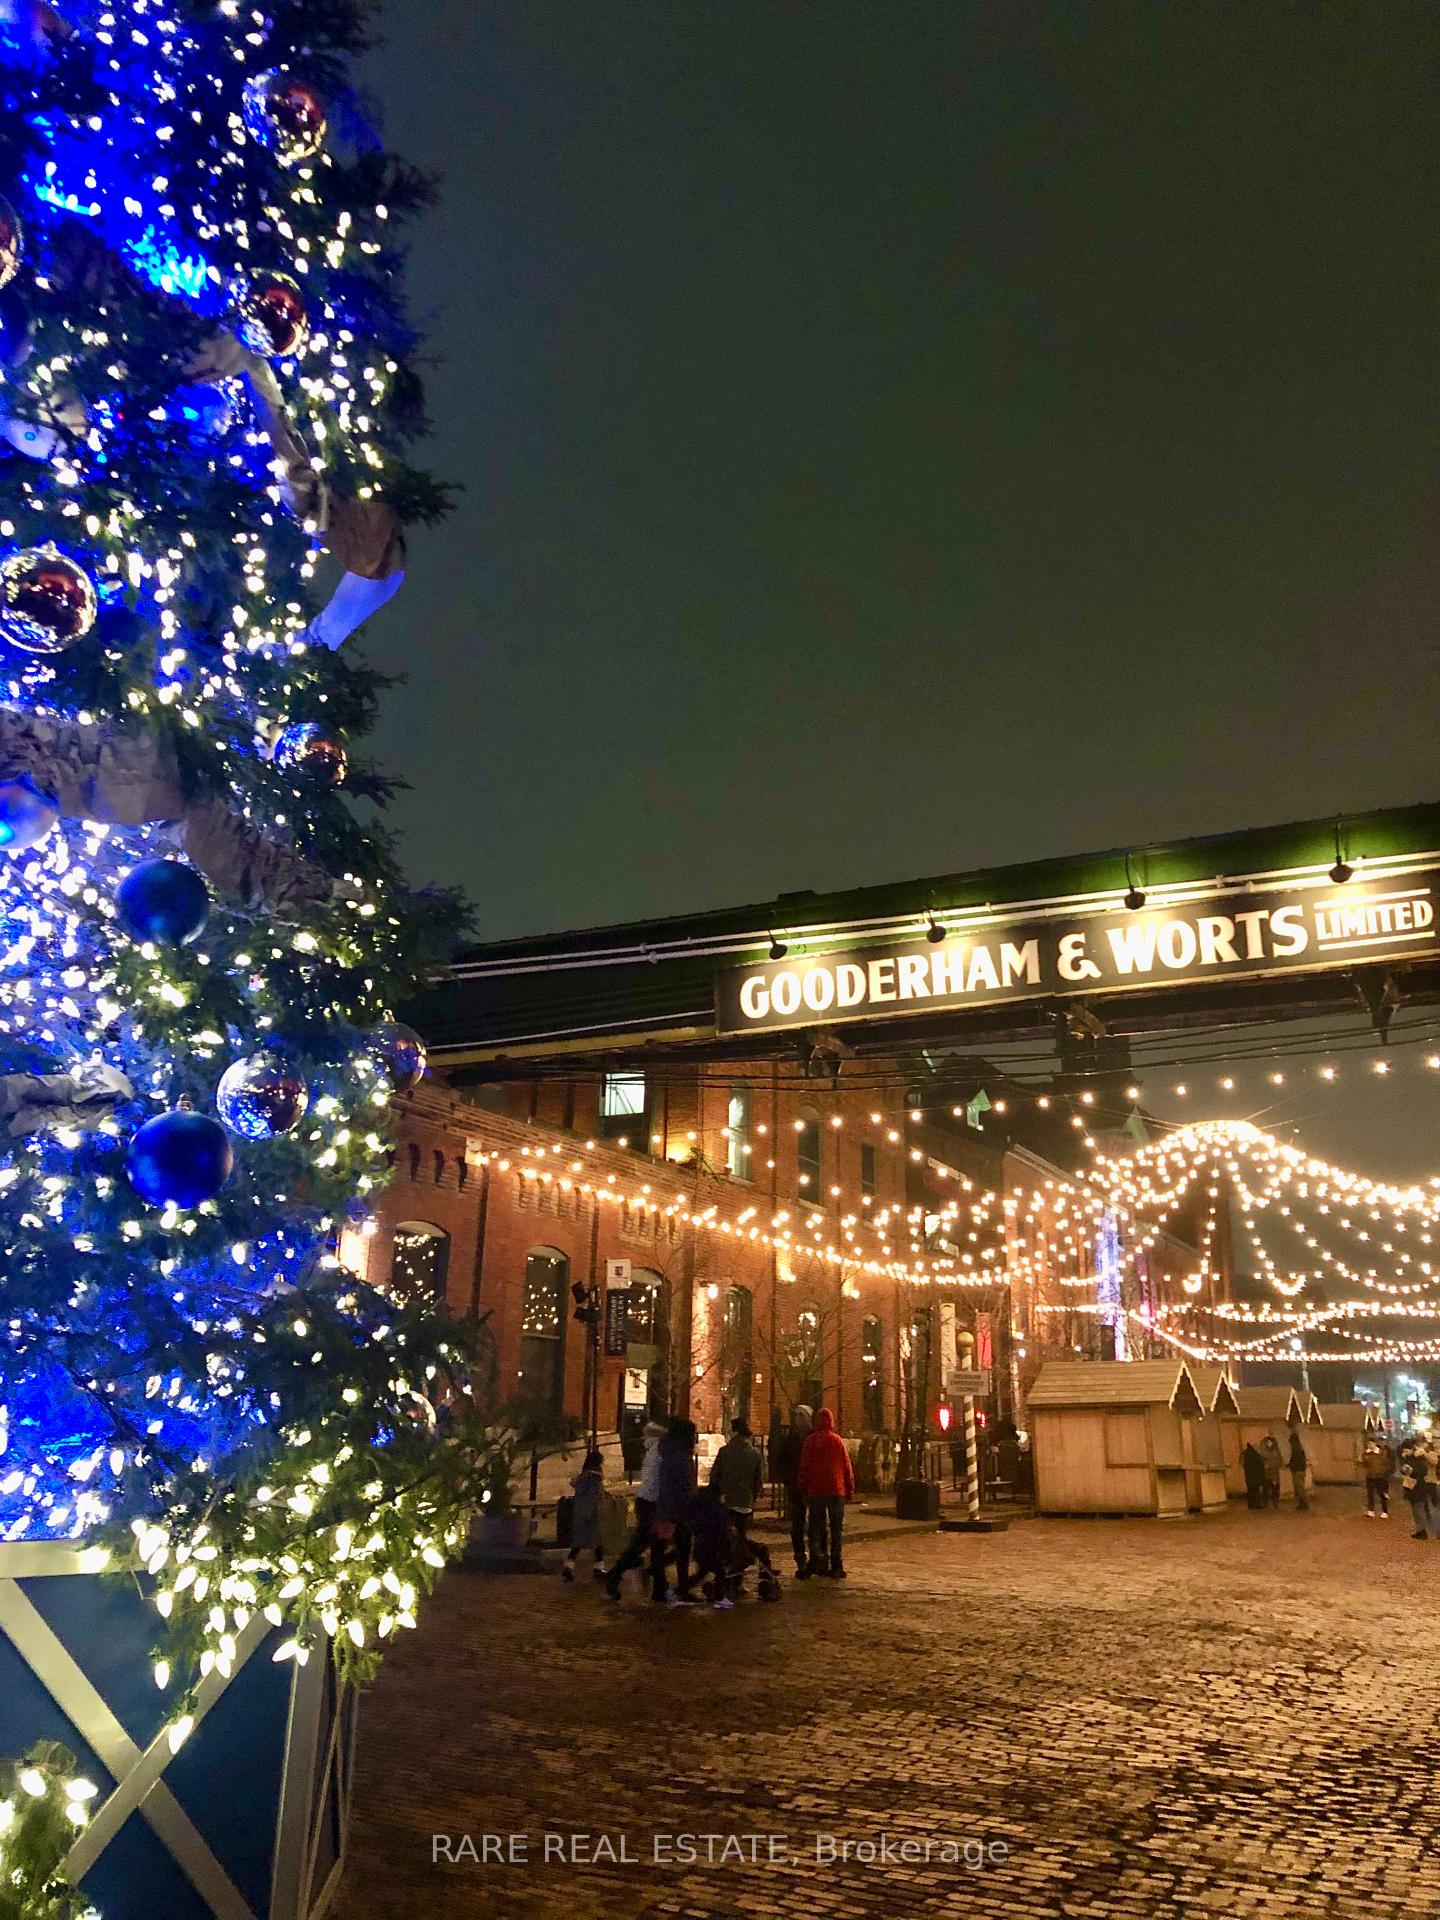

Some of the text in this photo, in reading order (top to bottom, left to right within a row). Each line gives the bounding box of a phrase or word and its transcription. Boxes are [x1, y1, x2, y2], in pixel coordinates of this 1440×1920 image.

[739, 899, 1434, 1019] GOODERHAM & WORTS LIMITED
